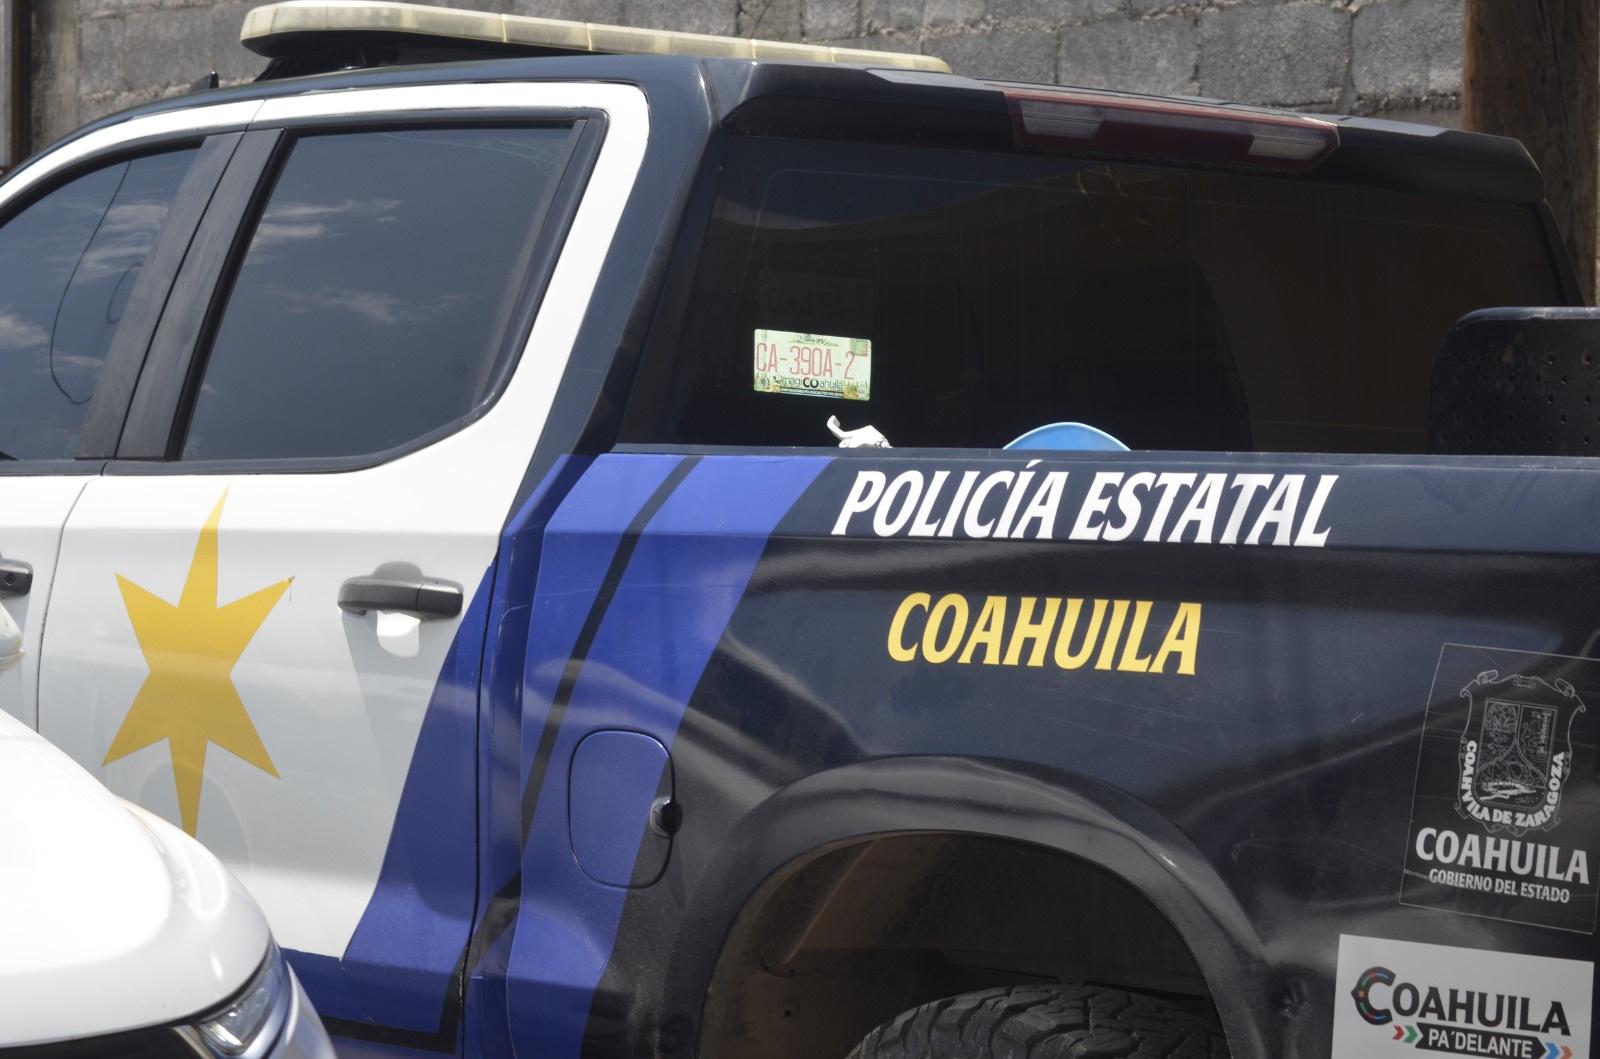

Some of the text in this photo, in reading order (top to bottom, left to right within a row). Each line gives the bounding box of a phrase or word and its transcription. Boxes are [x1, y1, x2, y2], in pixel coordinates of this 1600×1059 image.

[756, 343, 857, 380] CA-390A-2
[831, 459, 1339, 548] POLICÍA ESTATAL
[887, 592, 1202, 676] COAHUILA
[1492, 808, 1513, 825] DE
[1514, 751, 1565, 828] ZARAGOZA
[1415, 827, 1590, 885] COAHUILA
[1429, 868, 1571, 903] GOBIERNO DEL ESTADO
[1351, 966, 1571, 1037] COAHUILA
